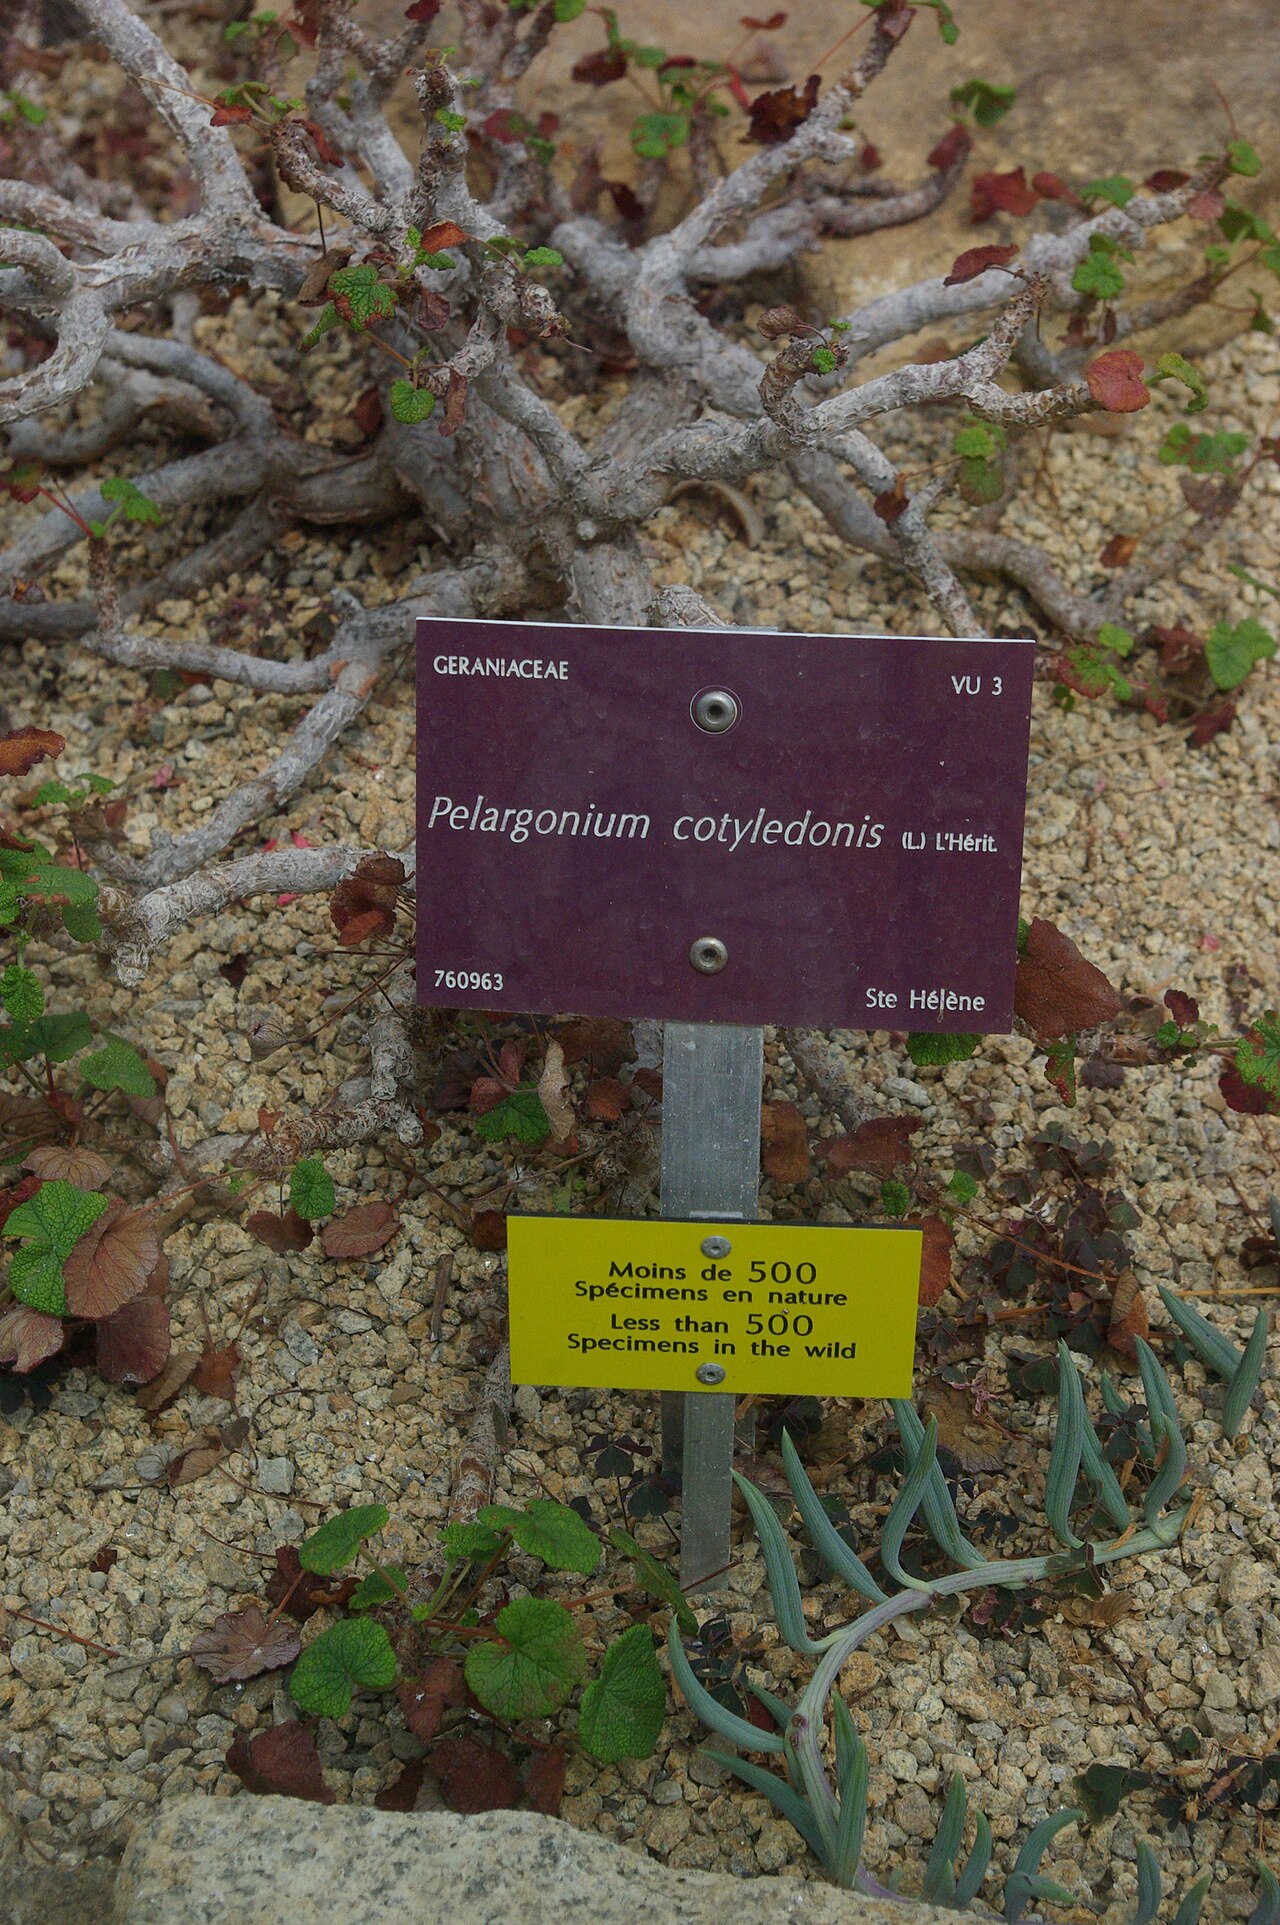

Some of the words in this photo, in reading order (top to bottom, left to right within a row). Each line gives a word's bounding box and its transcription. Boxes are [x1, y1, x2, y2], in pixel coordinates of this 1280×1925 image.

[433, 655, 569, 681] GERANIACEAE
[950, 675, 981, 695] VU
[991, 676, 1003, 696] 3
[427, 795, 651, 843] Pelargonium
[672, 807, 885, 852] cotyledonis
[434, 969, 504, 991] 760963
[865, 987, 898, 1009] Ste
[909, 988, 986, 1012] Hélène
[608, 1261, 687, 1281] Moins
[700, 1263, 732, 1282] de
[748, 1261, 818, 1284] 500
[574, 1280, 709, 1302] Spécimens
[722, 1289, 753, 1303] en
[768, 1290, 848, 1306] nature
[610, 1314, 660, 1332] Less
[674, 1315, 729, 1334] than
[745, 1314, 814, 1336] 500
[567, 1333, 700, 1354] Specimens
[713, 1338, 736, 1356] in
[750, 1340, 791, 1358] the
[804, 1341, 857, 1360] wild
